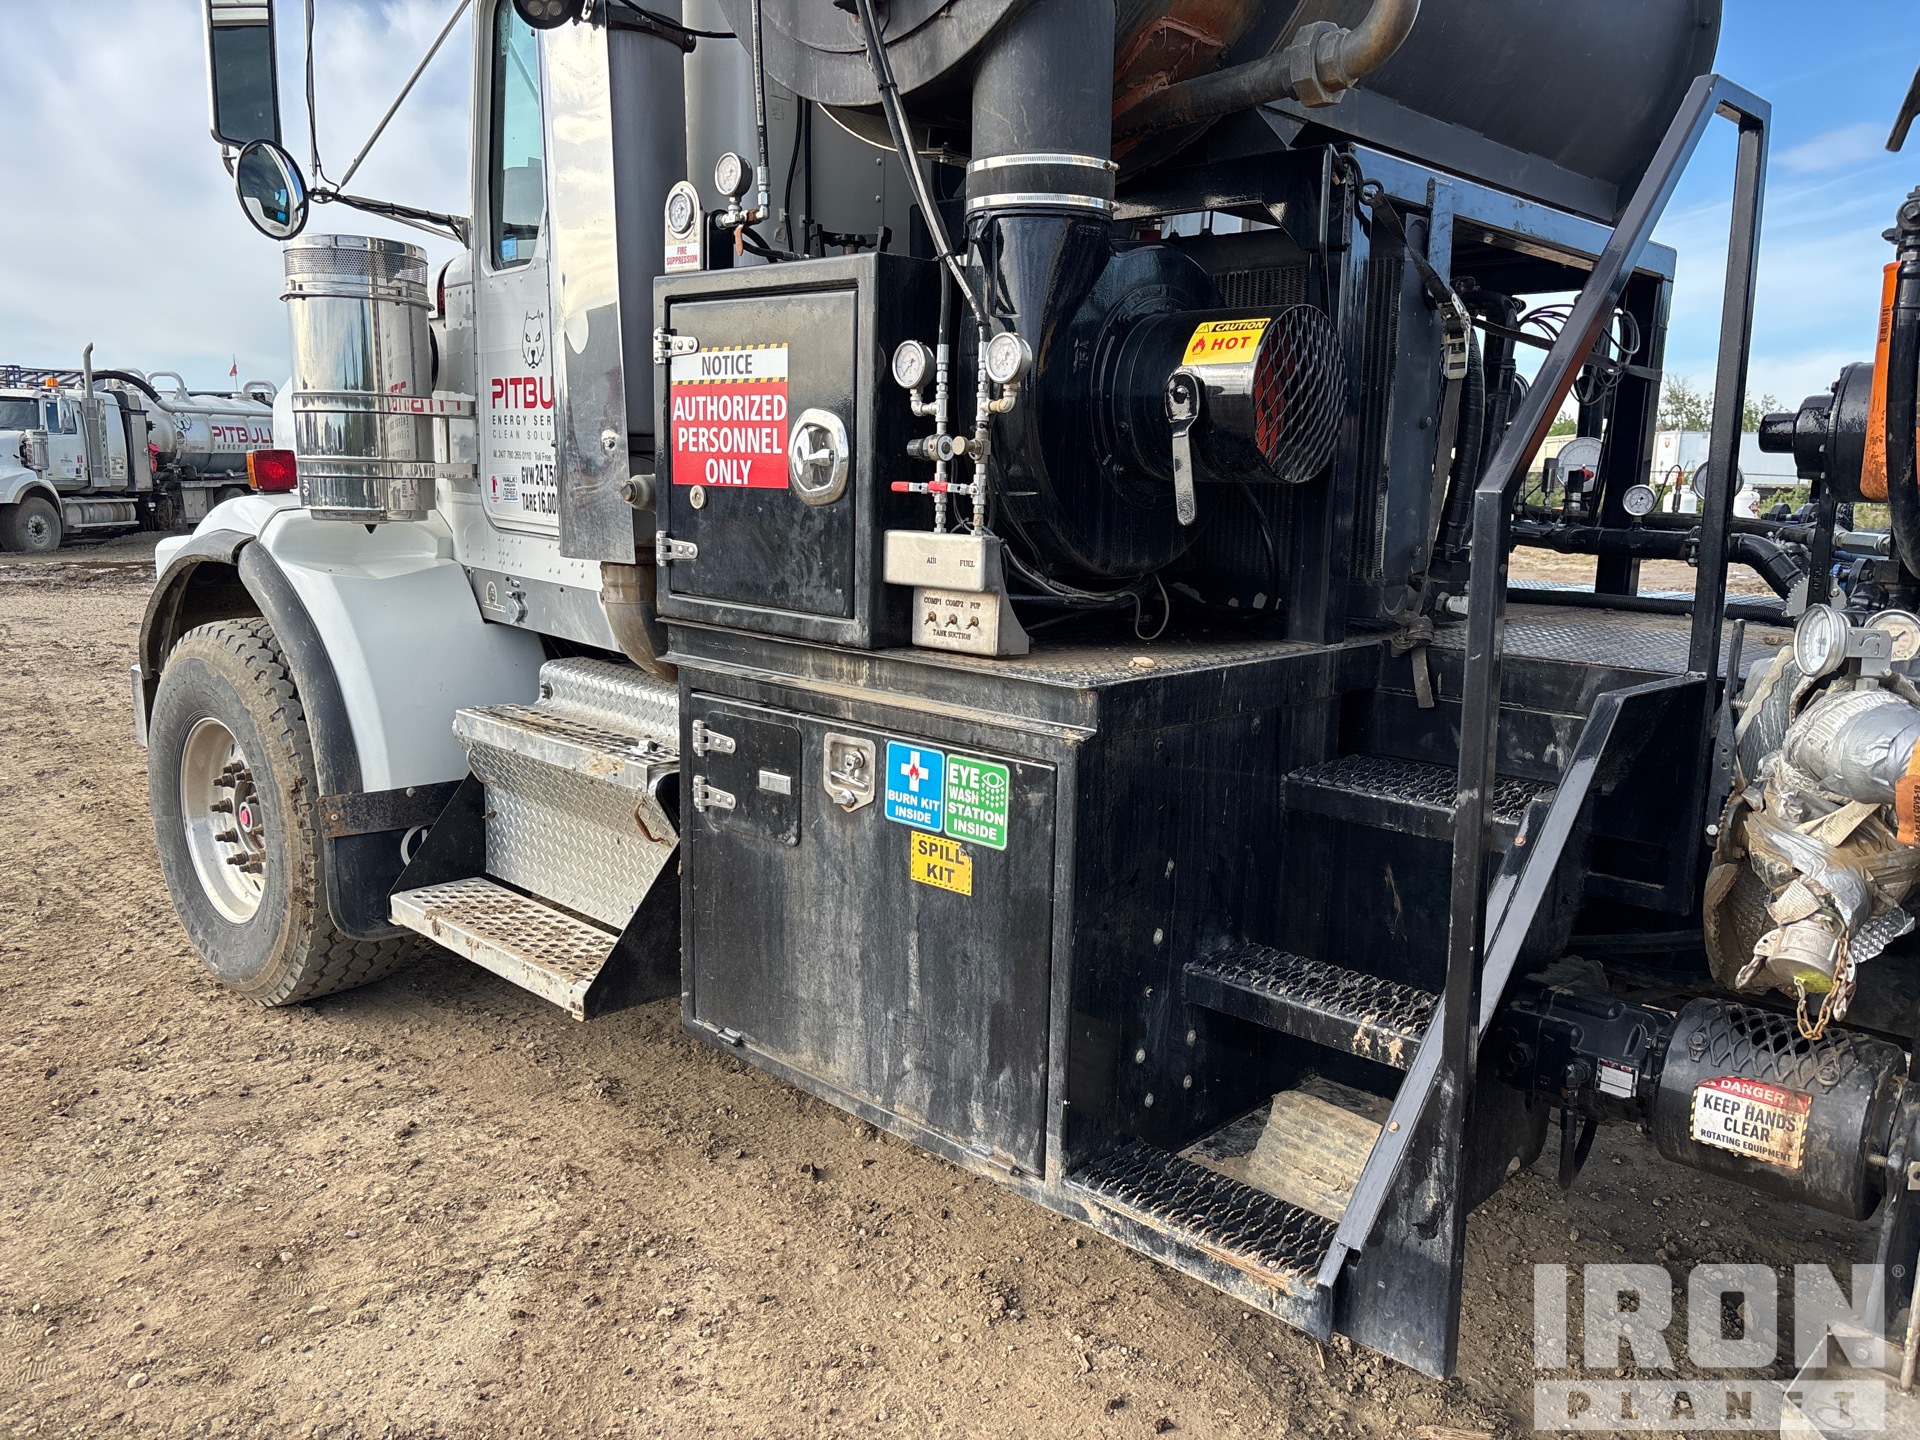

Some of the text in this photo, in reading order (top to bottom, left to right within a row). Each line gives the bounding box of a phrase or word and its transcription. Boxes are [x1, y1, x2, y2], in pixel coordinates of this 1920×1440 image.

[666, 254, 697, 265] SUPPRESSION
[677, 246, 687, 254] FIRE
[1215, 322, 1265, 331] CAUTION
[1211, 336, 1251, 350] HOT
[701, 354, 753, 376] NOTICE
[673, 394, 787, 422] AUTHORIZED
[492, 415, 527, 425] ENERGY
[492, 430, 520, 439] CLEAN
[678, 427, 782, 454] PERSONNEL
[521, 466, 535, 485] GVW
[705, 458, 752, 485] ONLY
[522, 492, 537, 512] TARE
[926, 557, 975, 568] AIR FUEL
[924, 596, 981, 610] COMP1 COMP2 PUP
[932, 629, 971, 640] TANK SUCTION
[949, 762, 980, 789] EYE
[888, 789, 940, 812] BURN KIT
[949, 785, 979, 805] WASH
[895, 805, 932, 824] INSIDE
[948, 801, 1005, 827] STATION
[953, 818, 998, 841] INSIDE
[918, 840, 965, 865] SPILL
[926, 862, 955, 884] KIT
[1720, 1080, 1786, 1105] DANGER
[1703, 1093, 1797, 1132] KEEP HANDS
[1724, 1117, 1770, 1143] CLEAR
[1700, 1128, 1792, 1162] ROTATING EQUIPMENT
